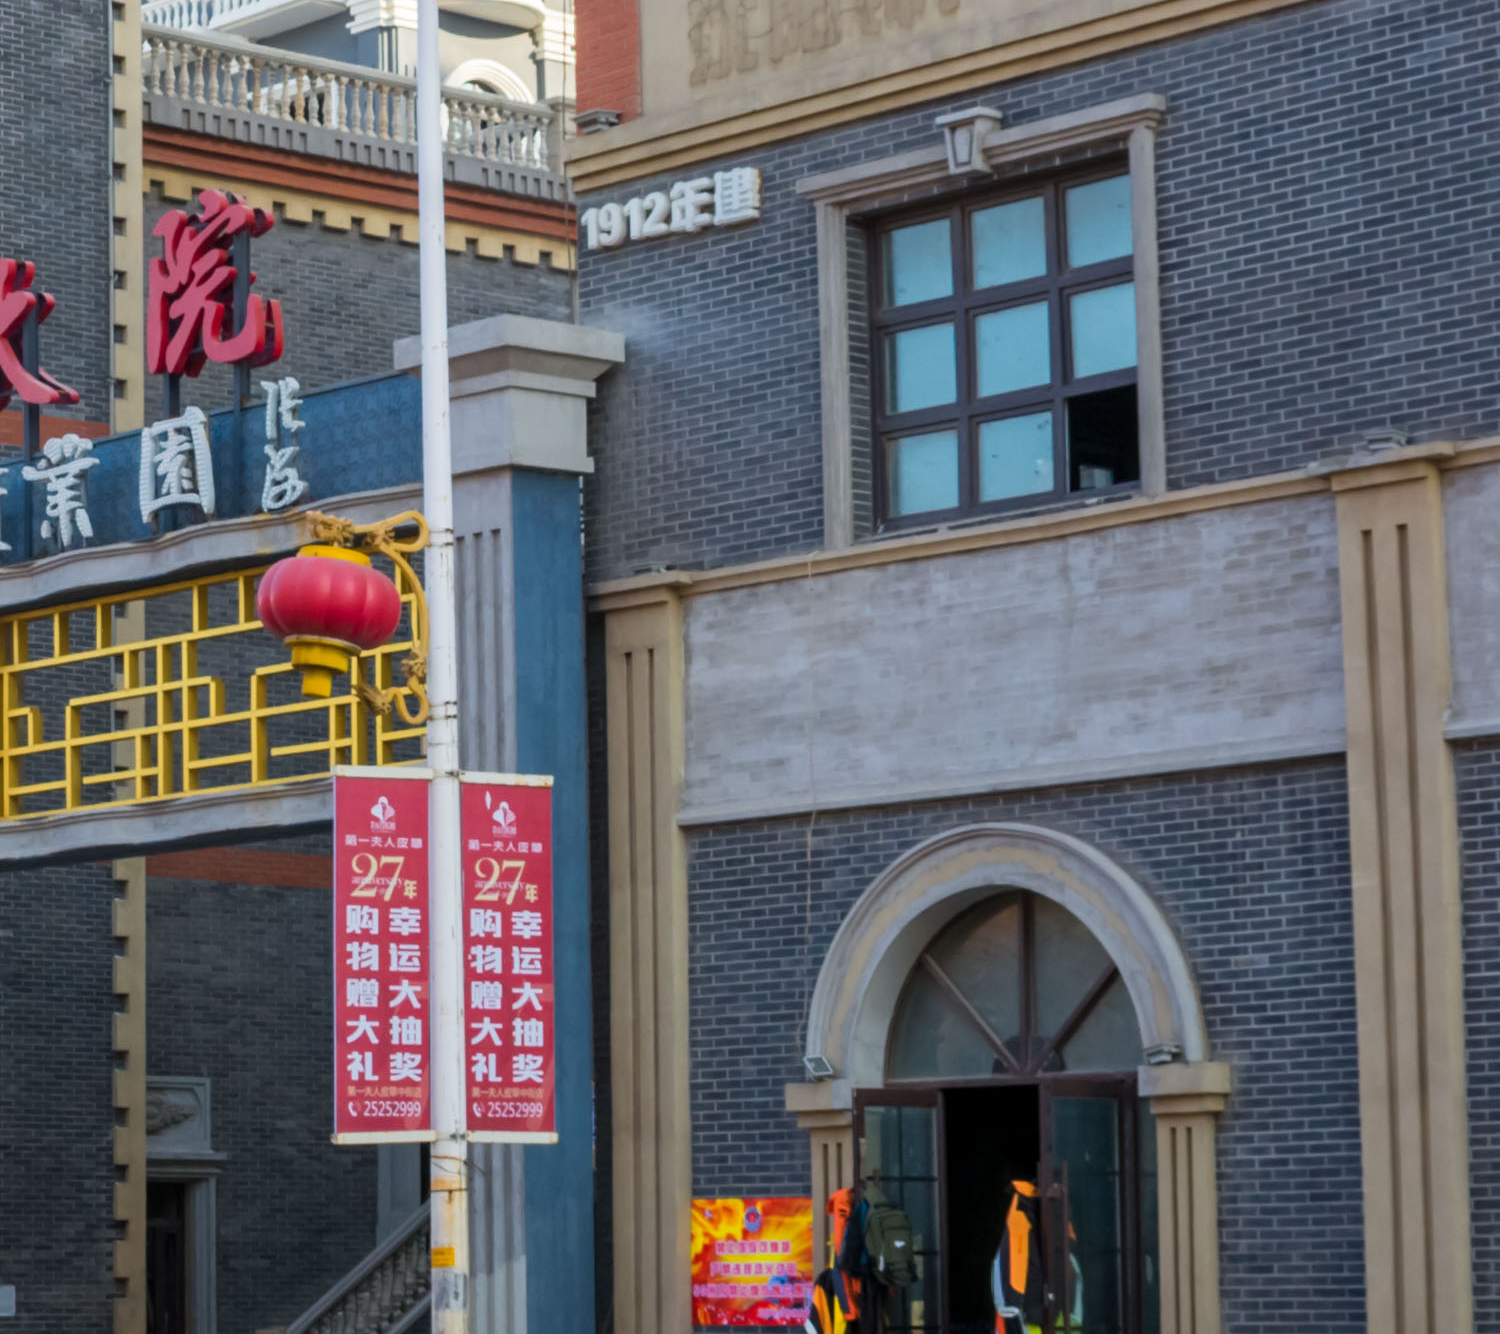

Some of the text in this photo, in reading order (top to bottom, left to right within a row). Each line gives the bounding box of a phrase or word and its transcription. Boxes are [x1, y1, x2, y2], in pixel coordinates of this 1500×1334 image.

[346, 905, 379, 1082] 购物赠大礼
[389, 907, 422, 1082] 幸运大抽奖
[470, 908, 502, 1083] 购物赠大礼
[511, 910, 544, 1083] 幸运大抽奖
[364, 1101, 421, 1117] 25252999
[488, 1101, 543, 1118] 25252999
